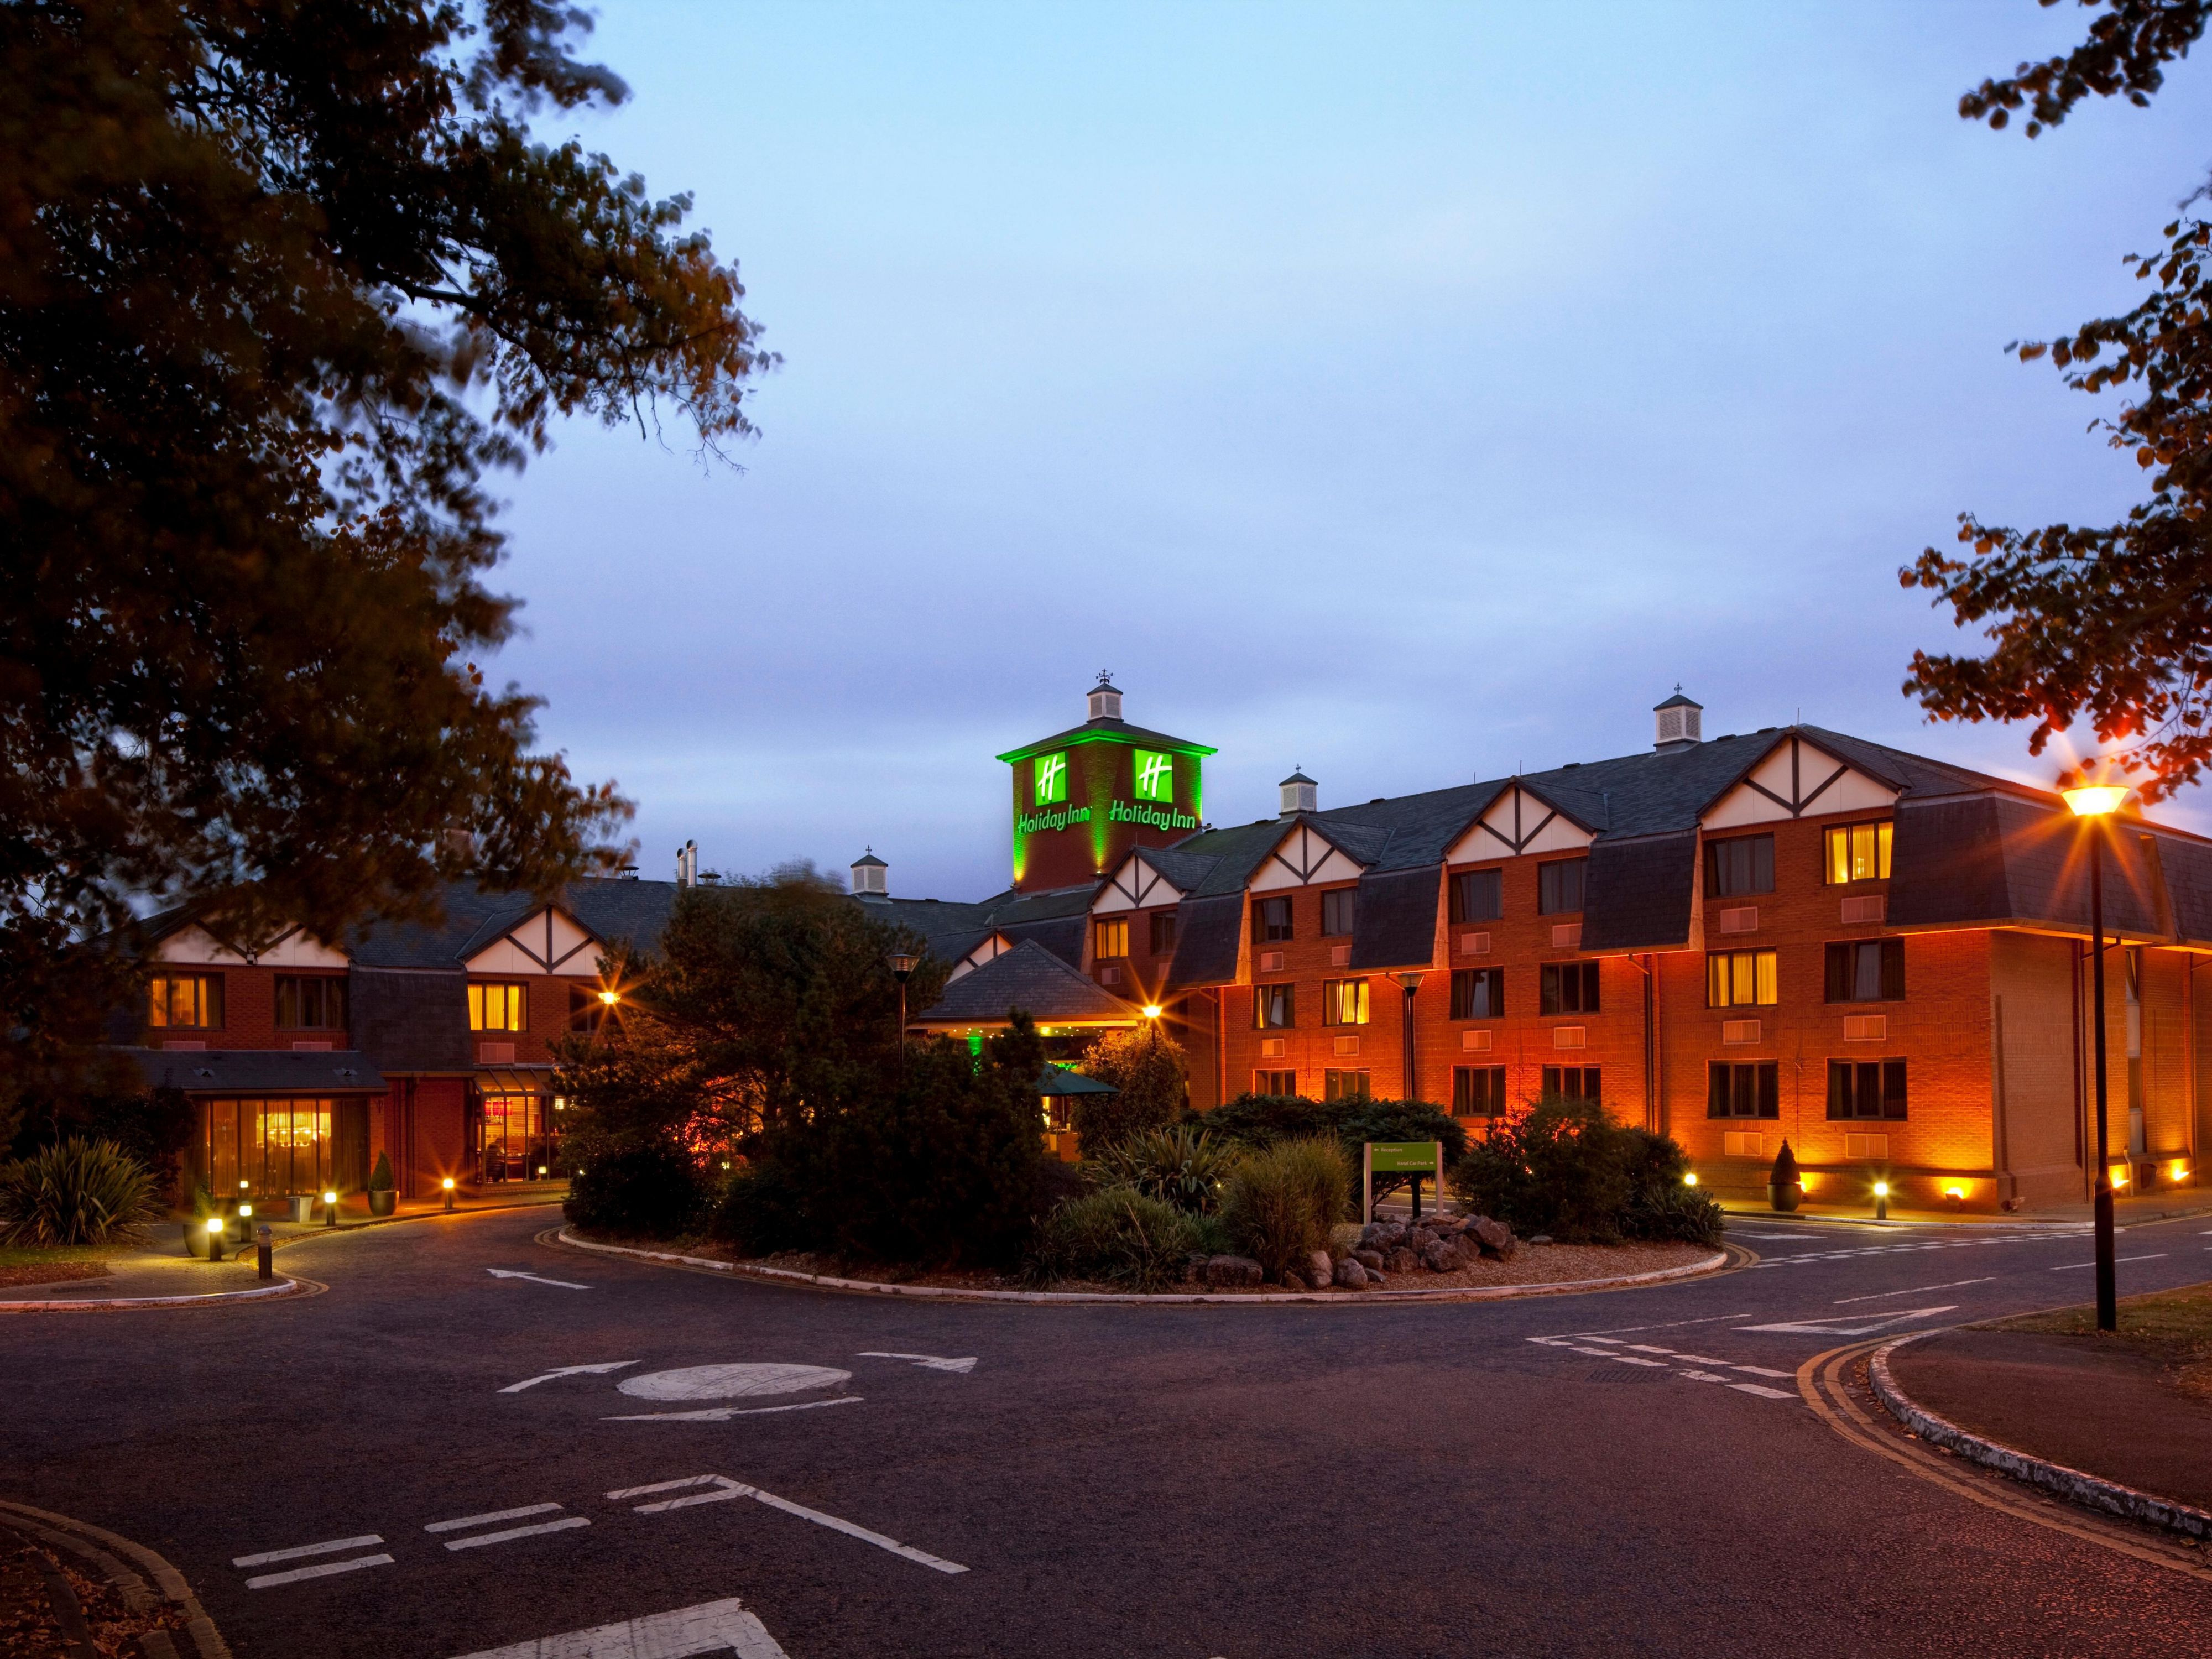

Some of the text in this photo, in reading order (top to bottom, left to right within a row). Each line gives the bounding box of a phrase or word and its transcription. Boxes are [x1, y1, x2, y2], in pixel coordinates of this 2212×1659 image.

[1018, 804, 1091, 834] Holiday Inn
[1109, 800, 1196, 831] Holiday Inn
